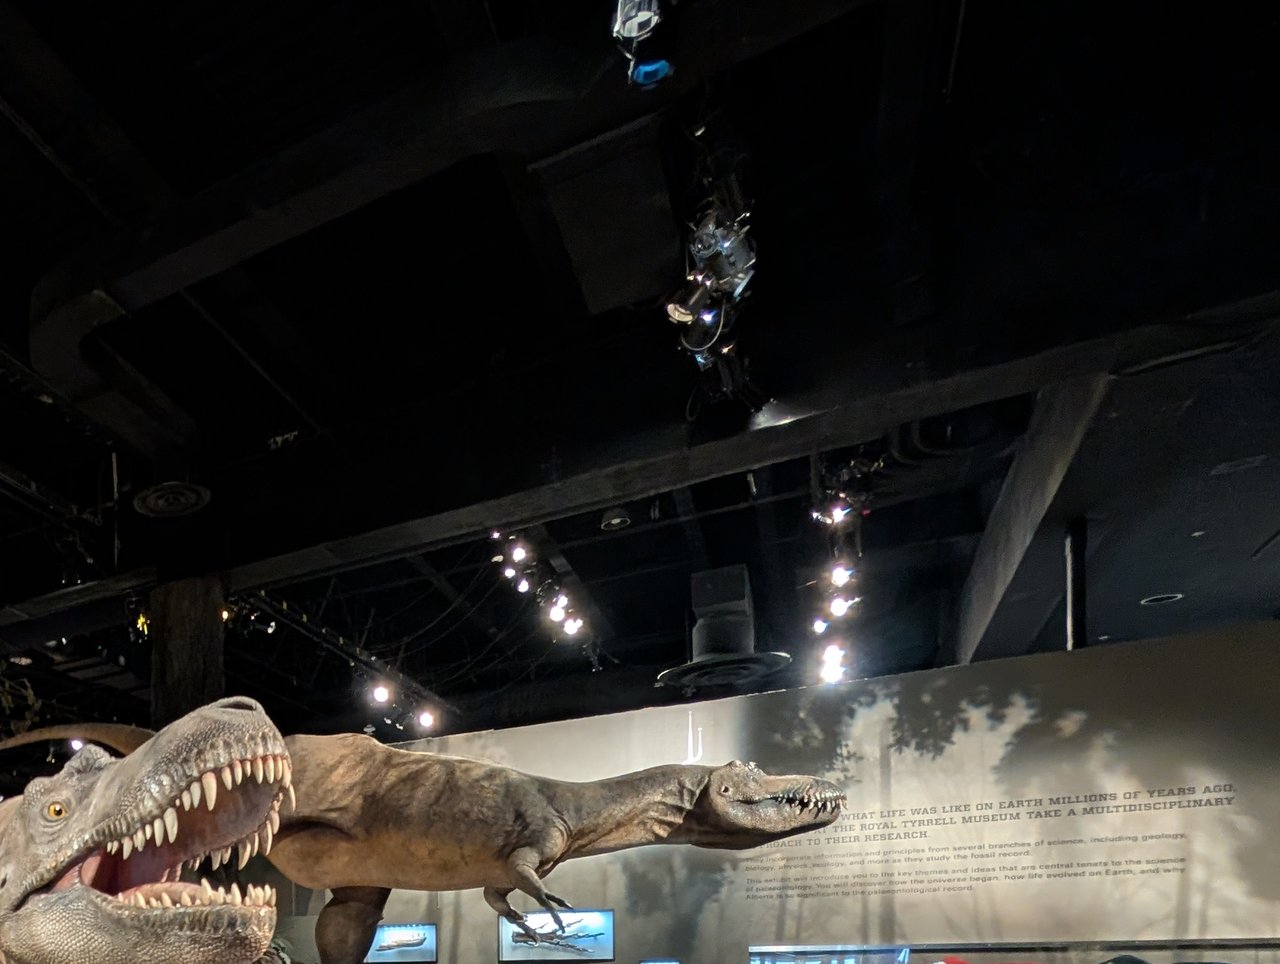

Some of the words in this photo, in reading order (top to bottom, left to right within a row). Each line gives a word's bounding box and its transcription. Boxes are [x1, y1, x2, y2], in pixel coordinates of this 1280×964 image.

[841, 811, 875, 821] WHAT
[880, 809, 906, 818] LIFE
[911, 807, 937, 816] WAS
[942, 804, 971, 814] LIKE
[976, 802, 993, 811] ON
[999, 798, 1043, 809] EARTH
[1048, 793, 1117, 806] MILLIONS
[1123, 791, 1141, 800] OF
[1147, 786, 1196, 798] YEARS
[833, 824, 856, 833] THE
[860, 822, 897, 831] ROYAL
[901, 817, 957, 828] TYRRELL
[961, 812, 1021, 824] MUSEUM
[1026, 809, 1061, 819] TAKE
[1067, 808, 1077, 817] A
[1082, 796, 1235, 815] MULTIDISCIPLINARY
[807, 838, 821, 846] TO
[825, 835, 860, 845] THEIR
[883, 847, 926, 857] principles
[952, 844, 985, 852] several
[988, 842, 1031, 850] branches
[1090, 834, 1138, 843] including
[904, 855, 923, 863] they
[926, 854, 951, 863] study
[971, 851, 995, 859] fossil
[998, 850, 1032, 858] record.
[915, 868, 949, 876] themes
[971, 866, 996, 874] ideas
[1039, 862, 1074, 870] central
[1046, 870, 1086, 879] evolved
